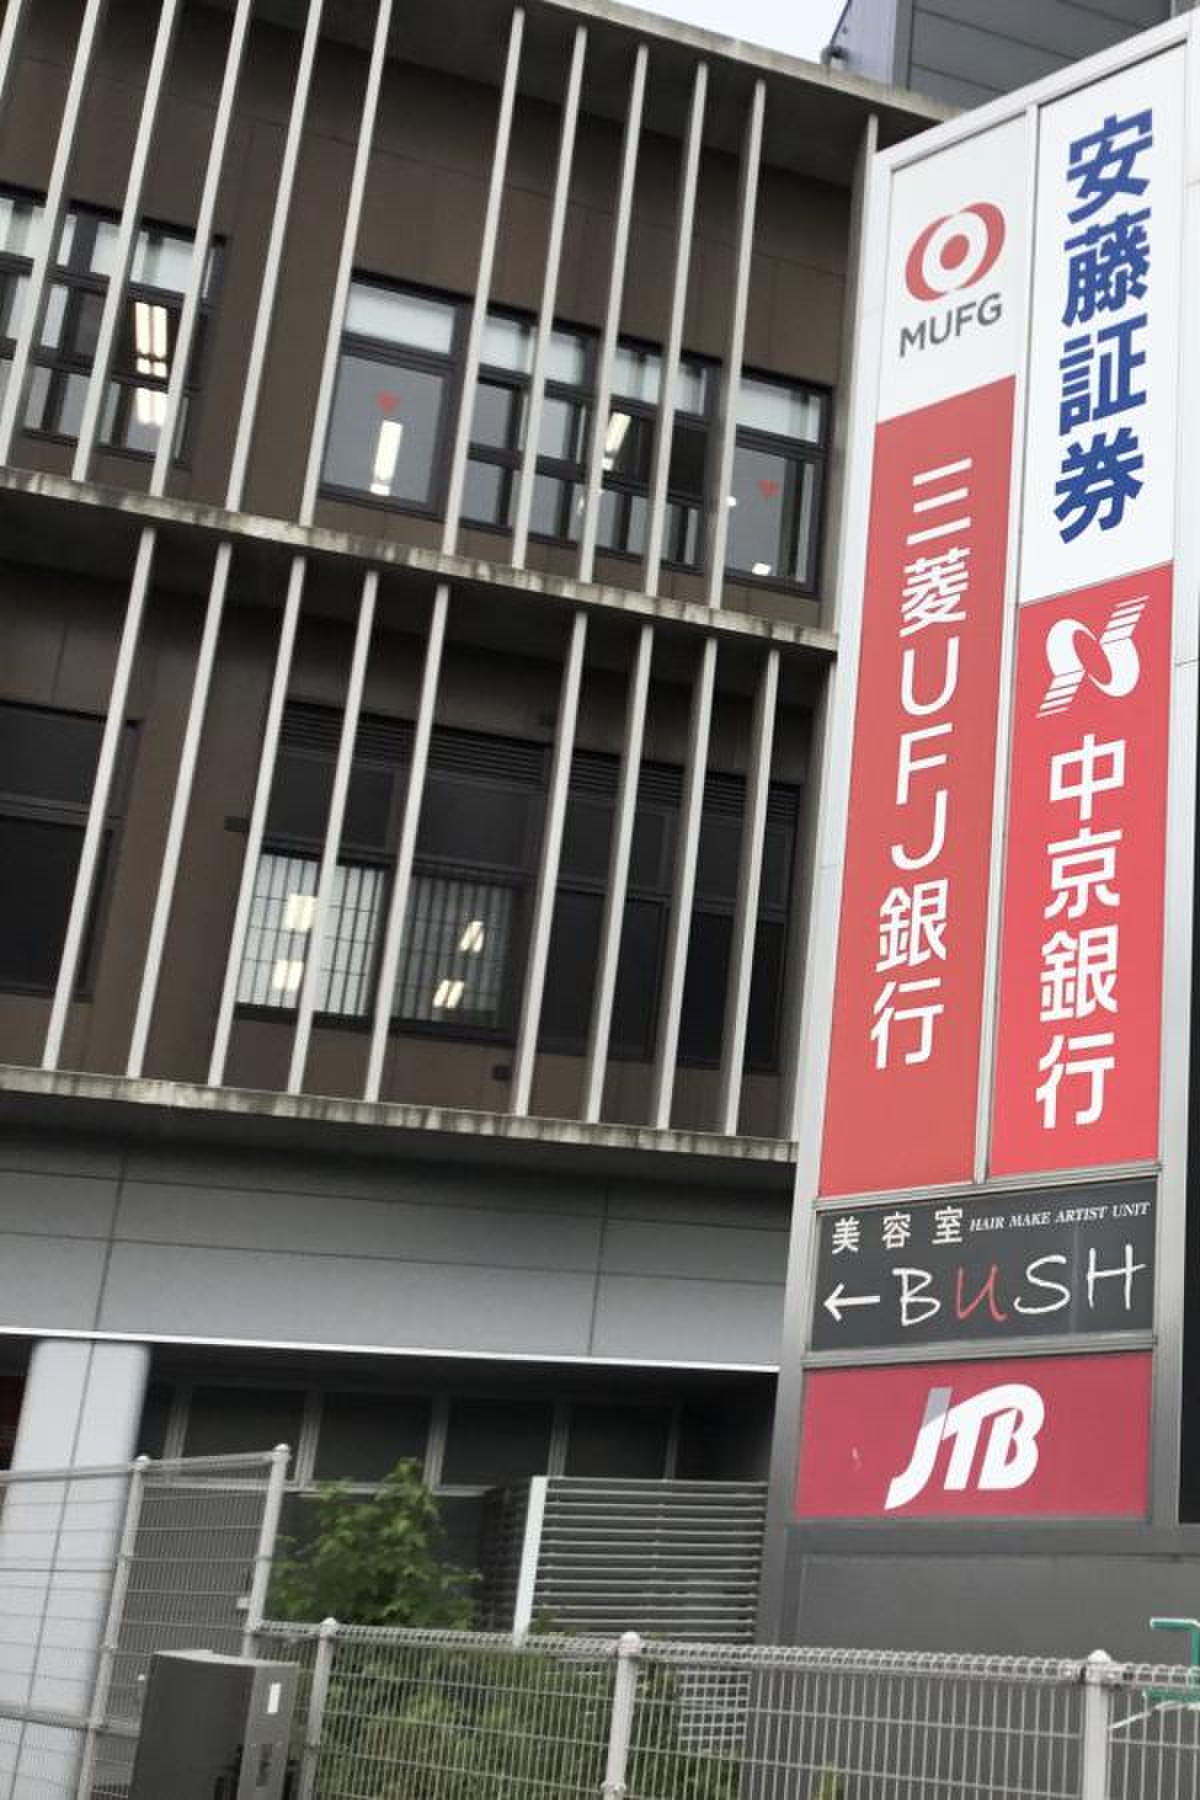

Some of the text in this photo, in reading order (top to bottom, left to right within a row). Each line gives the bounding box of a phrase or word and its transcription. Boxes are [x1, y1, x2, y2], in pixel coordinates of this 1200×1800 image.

[900, 293, 1002, 358] MUFG
[1054, 108, 1153, 544] 安藤証券
[870, 457, 973, 1071] 三菱UFJ銀行
[1036, 734, 1127, 1129] 中京銀行
[832, 1206, 963, 1255] 美容室
[970, 1201, 1151, 1232] HAIR MAKE ARTIST UNIT
[892, 1243, 1147, 1327] BUSH
[884, 1383, 1045, 1511] JTB
